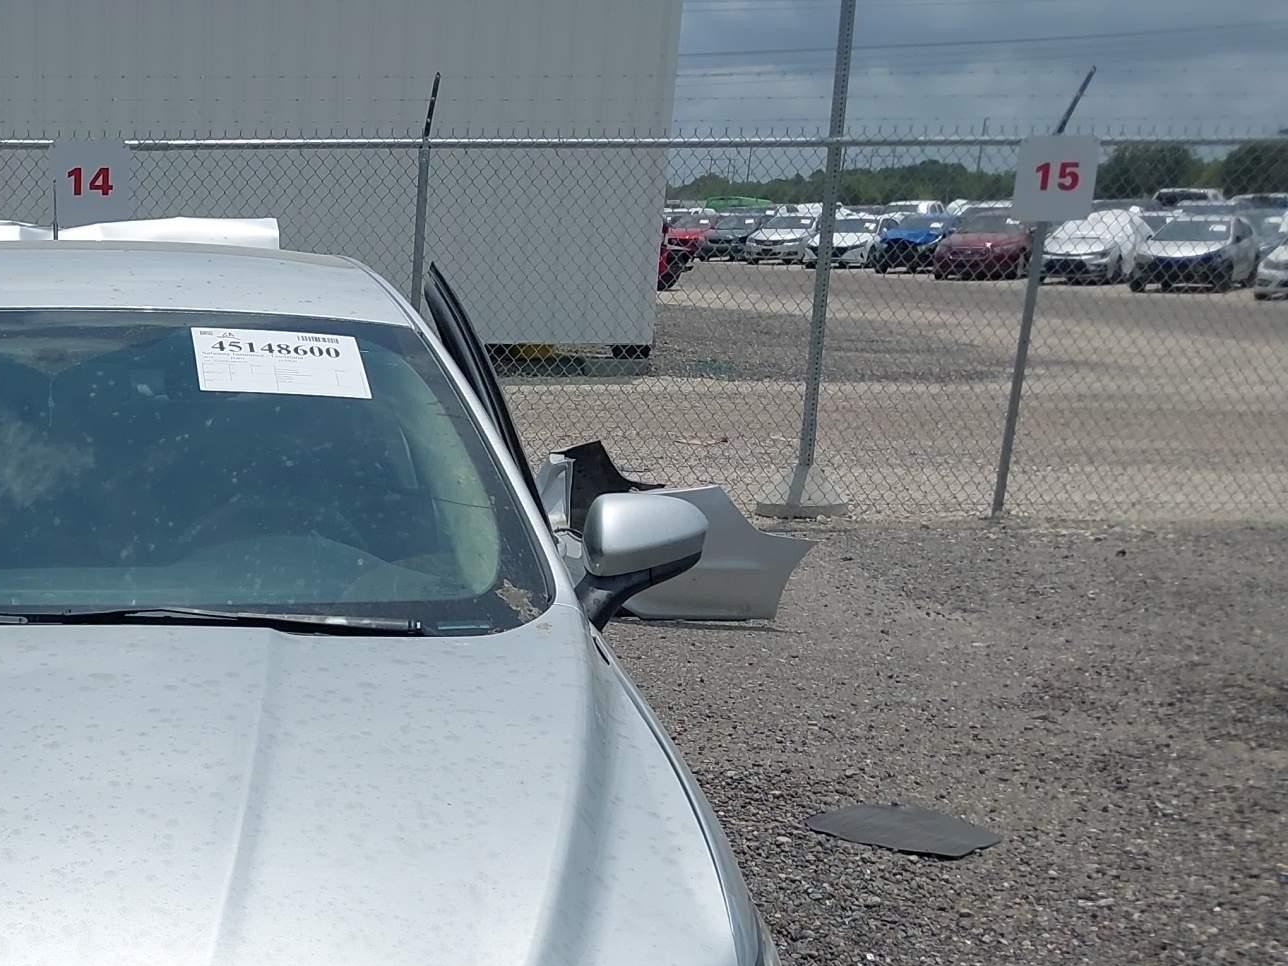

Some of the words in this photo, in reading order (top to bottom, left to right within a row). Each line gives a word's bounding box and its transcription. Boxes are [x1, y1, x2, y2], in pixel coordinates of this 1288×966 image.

[67, 167, 113, 195] 14
[1035, 161, 1079, 191] 15
[211, 340, 340, 358] 45148600
